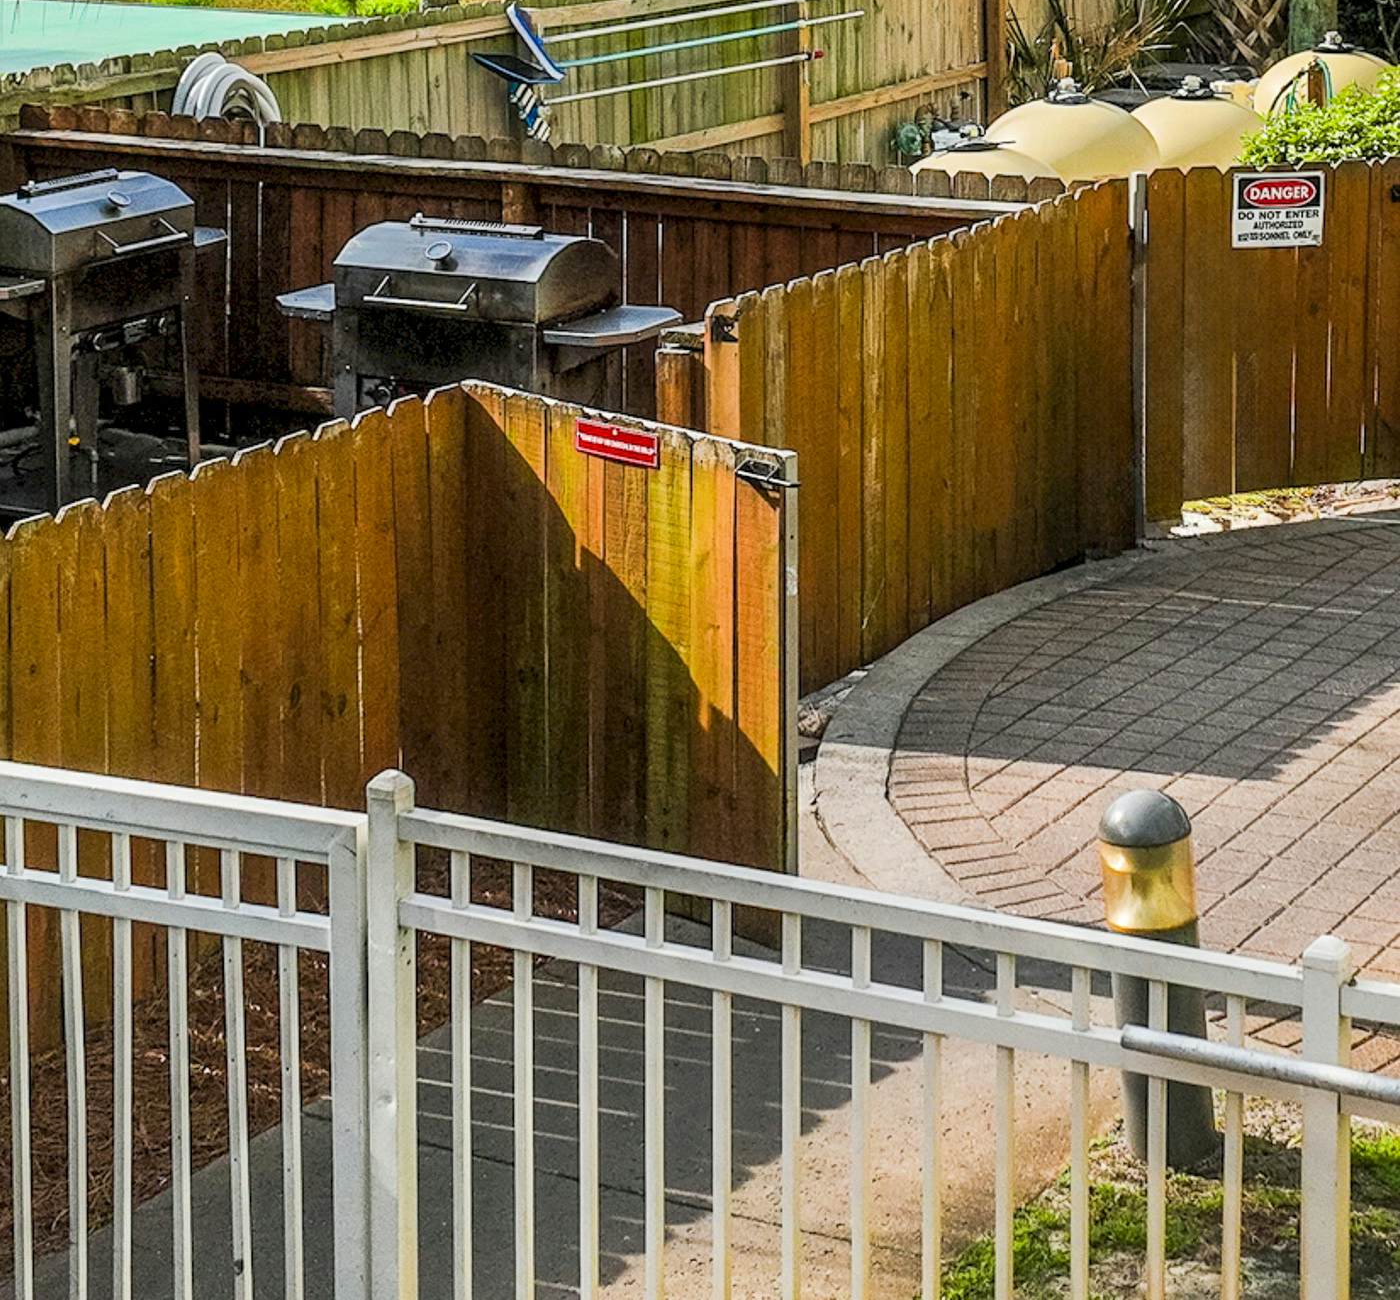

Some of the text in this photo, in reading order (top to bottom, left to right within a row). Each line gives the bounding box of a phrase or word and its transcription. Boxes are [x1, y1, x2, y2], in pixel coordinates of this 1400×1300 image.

[1249, 186, 1309, 200] DANGER
[1238, 210, 1319, 220] DO NOT ENTER
[1253, 220, 1303, 229] AUTHORIZED
[1293, 230, 1313, 239] ONLY
